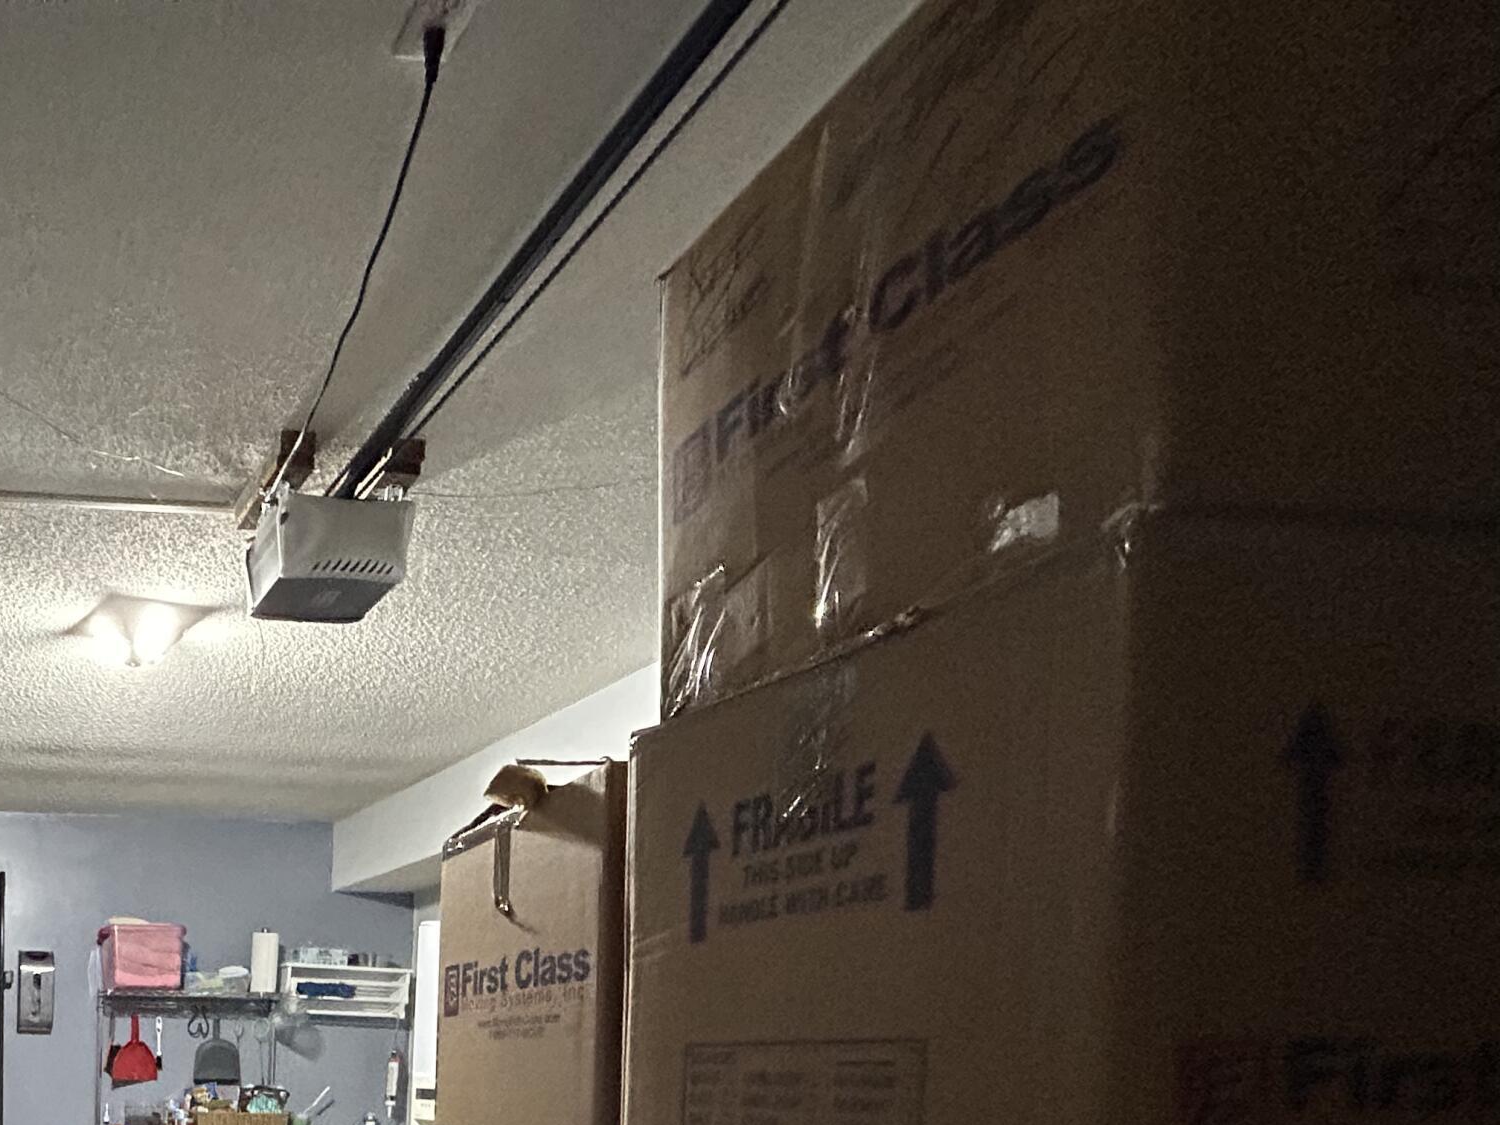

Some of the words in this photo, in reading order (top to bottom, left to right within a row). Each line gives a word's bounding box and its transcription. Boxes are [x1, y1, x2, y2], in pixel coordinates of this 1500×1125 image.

[868, 116, 1125, 333] Class
[461, 956, 509, 997] First
[515, 947, 591, 989] Class
